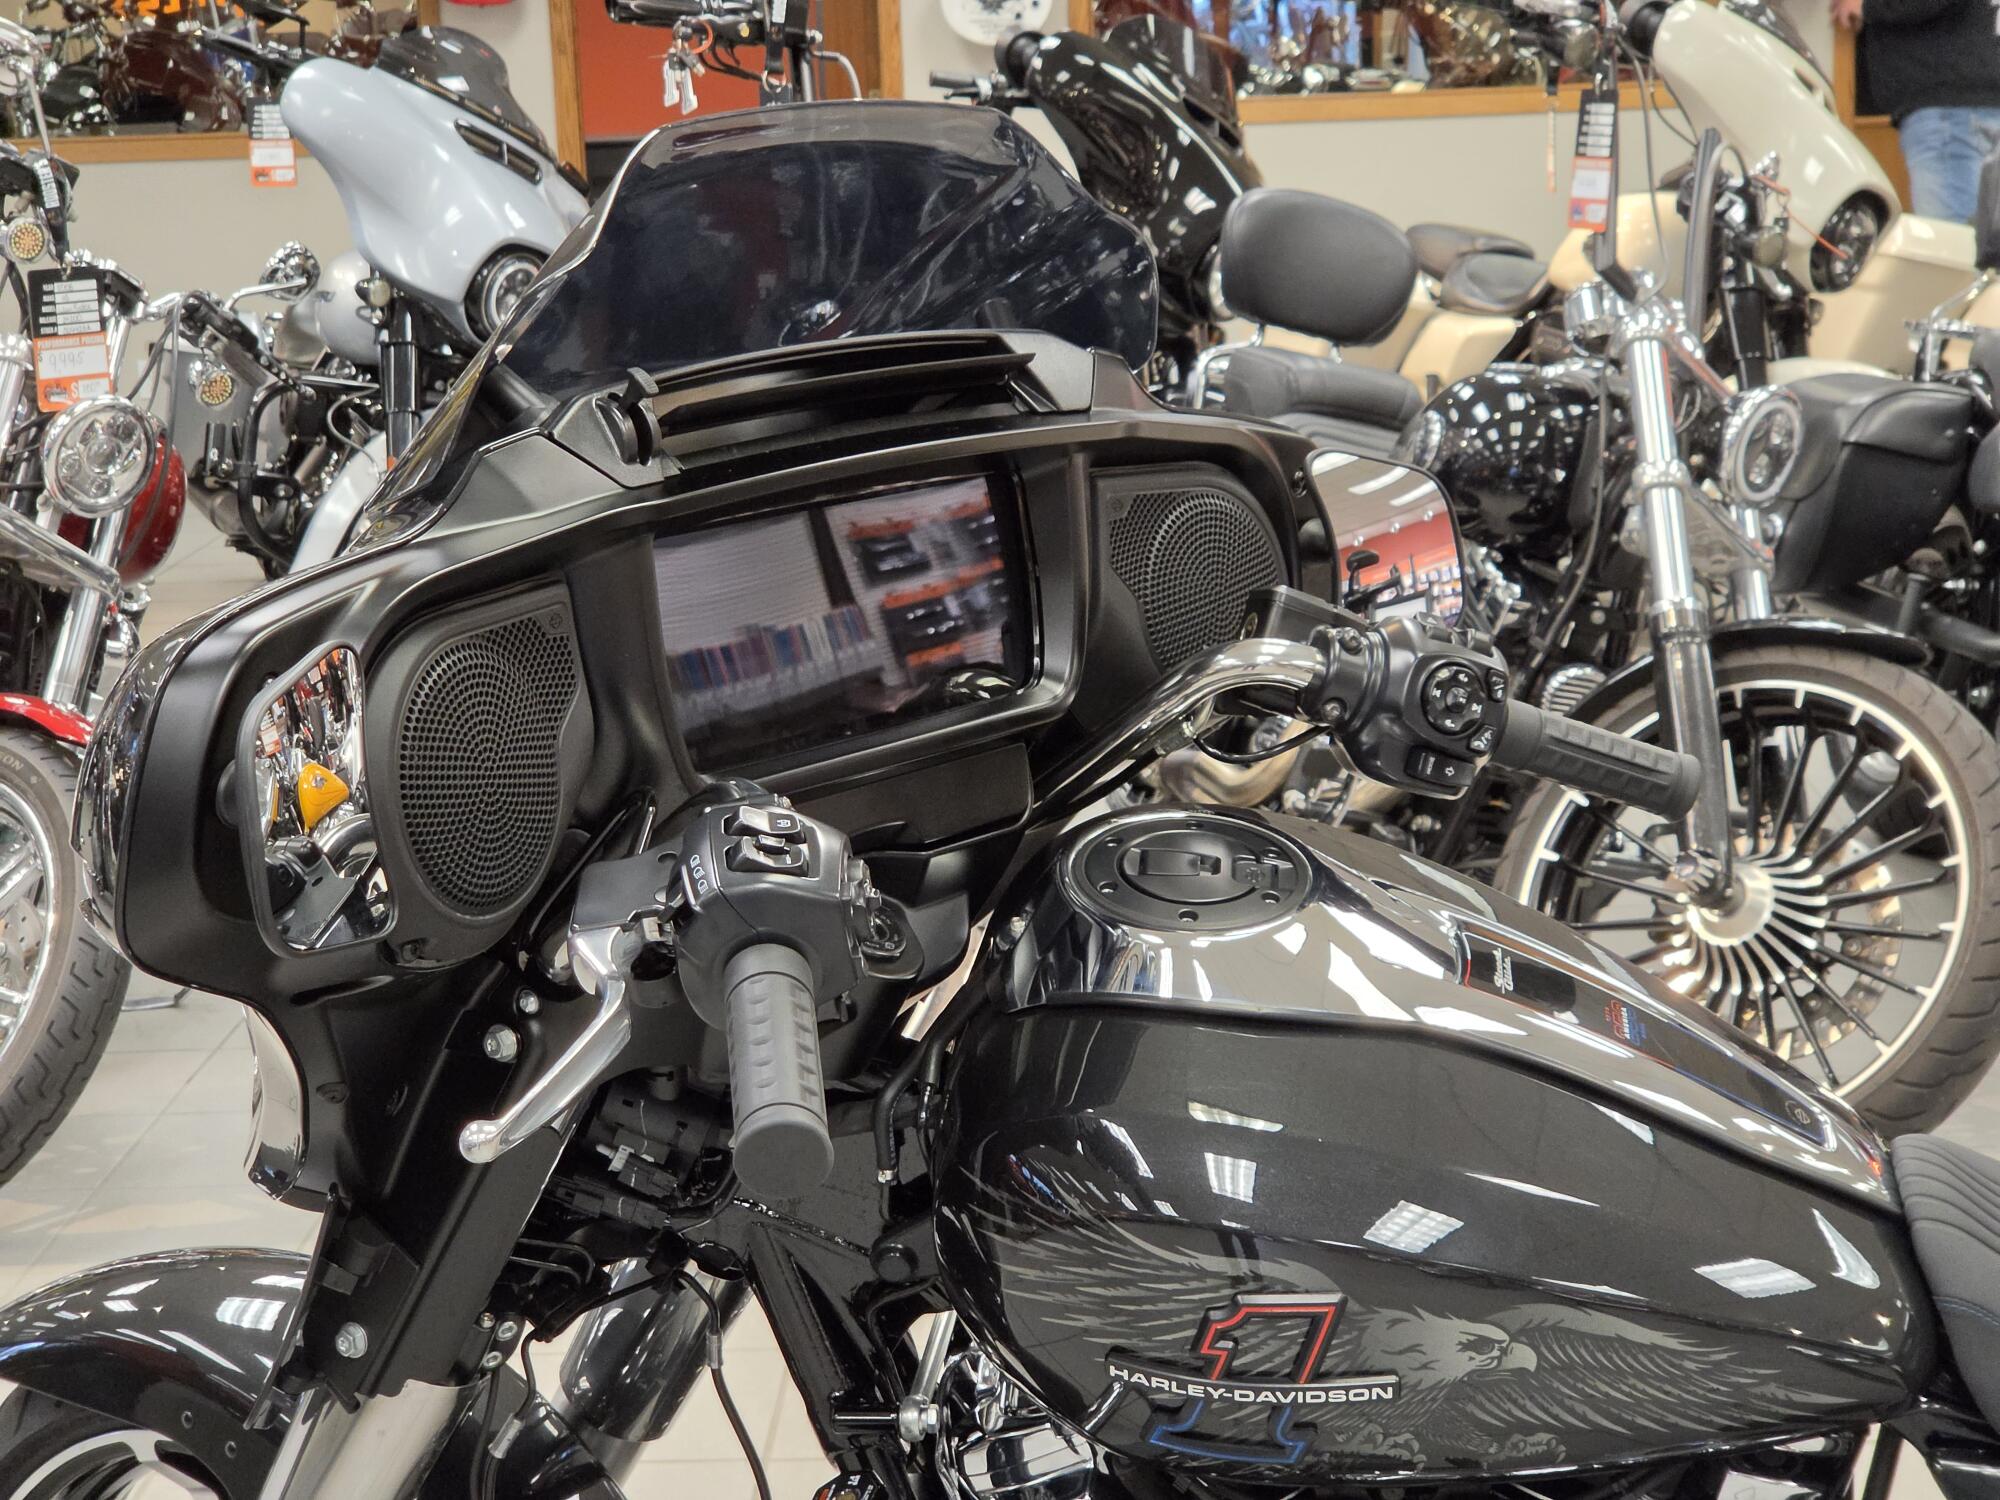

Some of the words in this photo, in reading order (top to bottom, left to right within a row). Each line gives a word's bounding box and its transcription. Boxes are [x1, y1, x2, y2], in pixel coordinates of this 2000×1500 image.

[1492, 947, 1504, 988] Street
[1502, 956, 1513, 992] Glide
[1108, 1364, 1393, 1404] HARLEY-DAVIDSON
